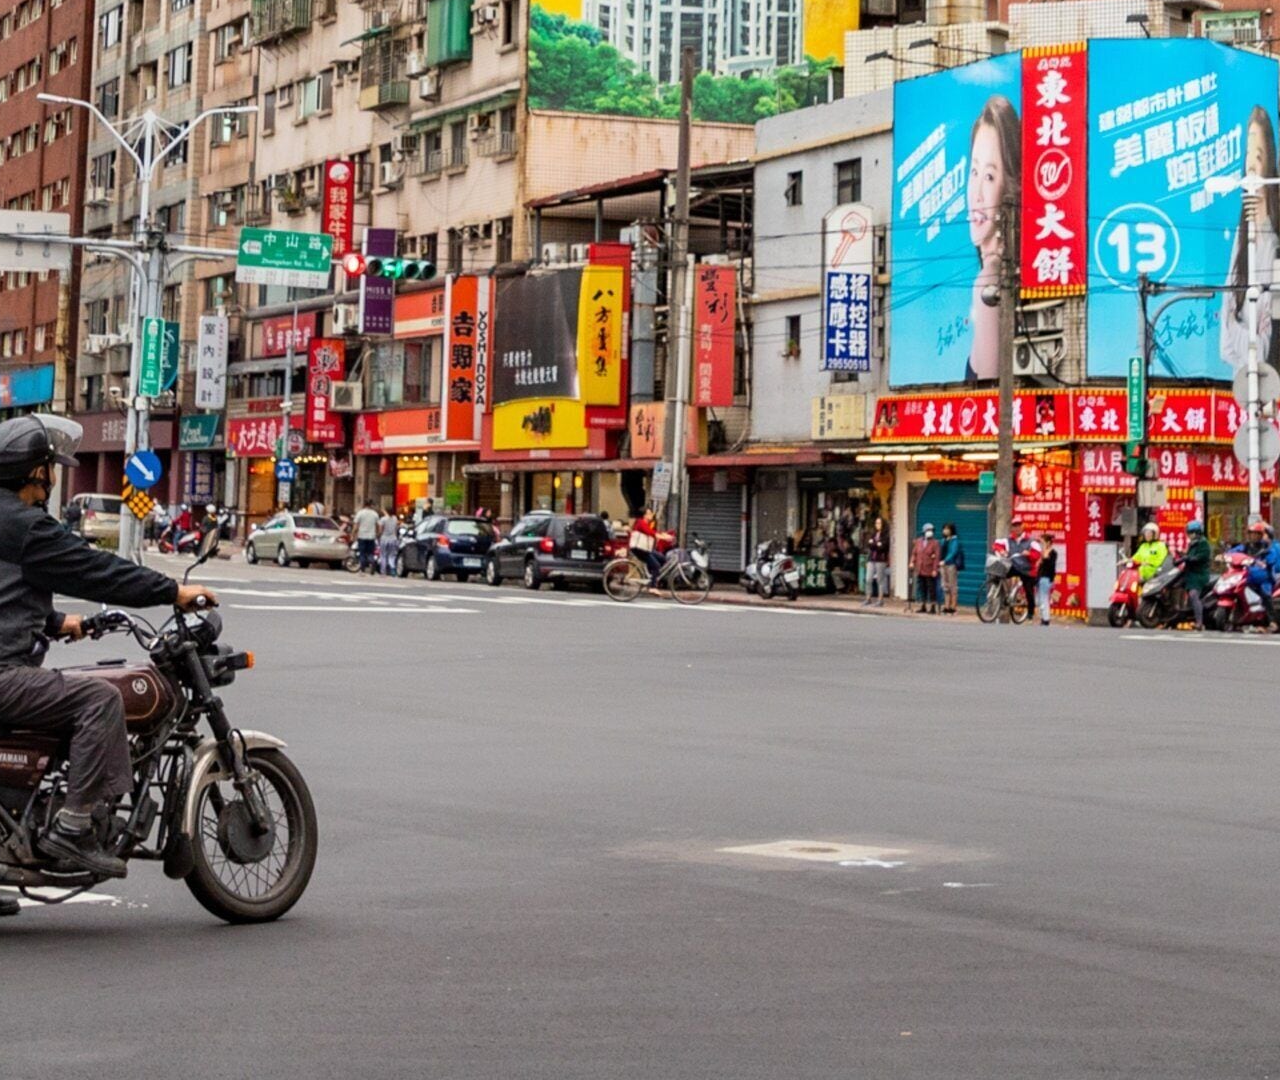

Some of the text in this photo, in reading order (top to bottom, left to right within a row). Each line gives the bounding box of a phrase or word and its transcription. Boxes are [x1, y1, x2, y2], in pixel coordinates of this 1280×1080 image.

[264, 232, 322, 250] 中山路
[1107, 222, 1166, 274] 13
[451, 311, 475, 404] 吉野家
[1079, 408, 1206, 433] 東北 大餅
